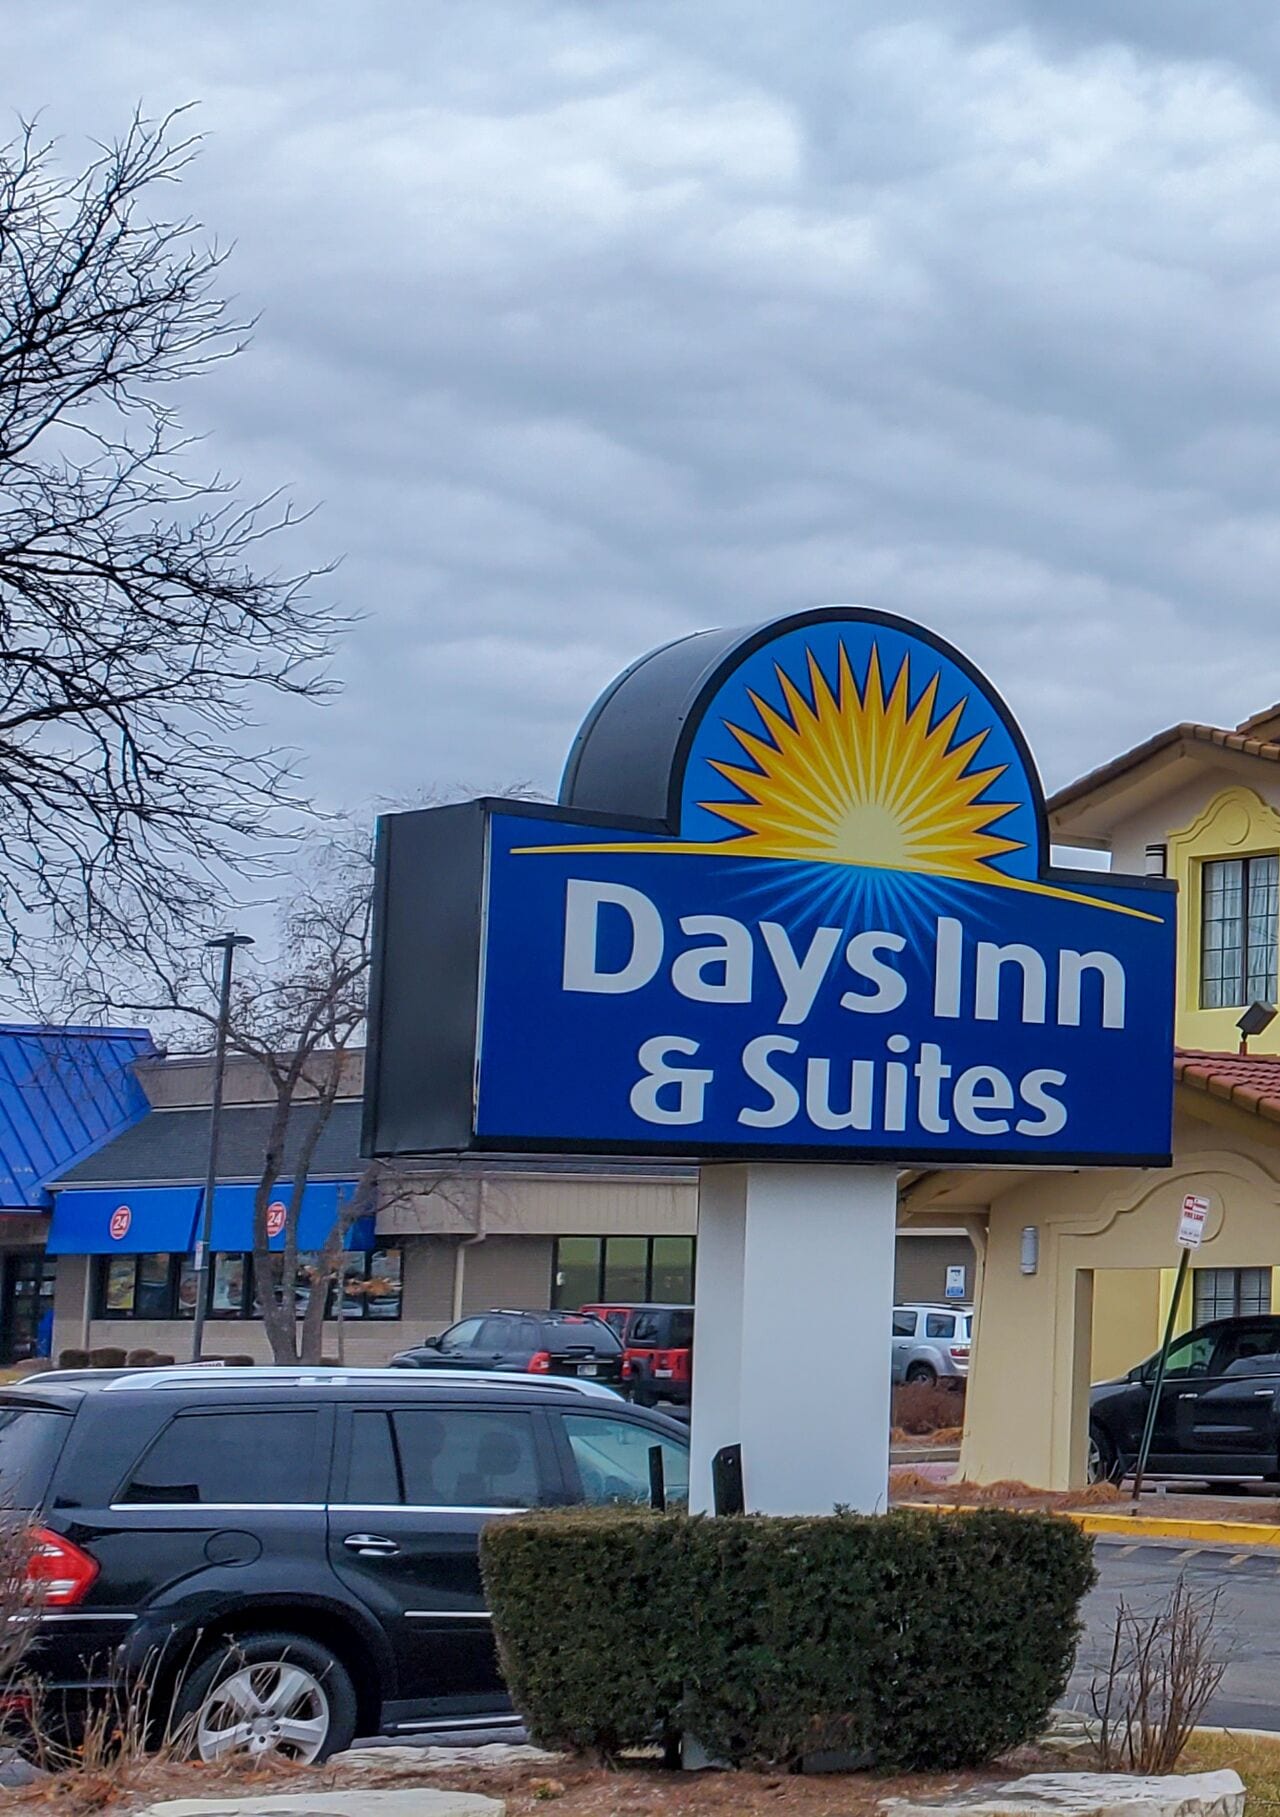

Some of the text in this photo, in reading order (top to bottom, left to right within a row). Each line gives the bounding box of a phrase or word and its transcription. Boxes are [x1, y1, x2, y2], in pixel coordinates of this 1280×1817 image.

[562, 878, 1126, 1029] Days Inn
[629, 1034, 1068, 1137] & Suites
[113, 1215, 128, 1230] 24
[267, 1212, 282, 1227] 24
